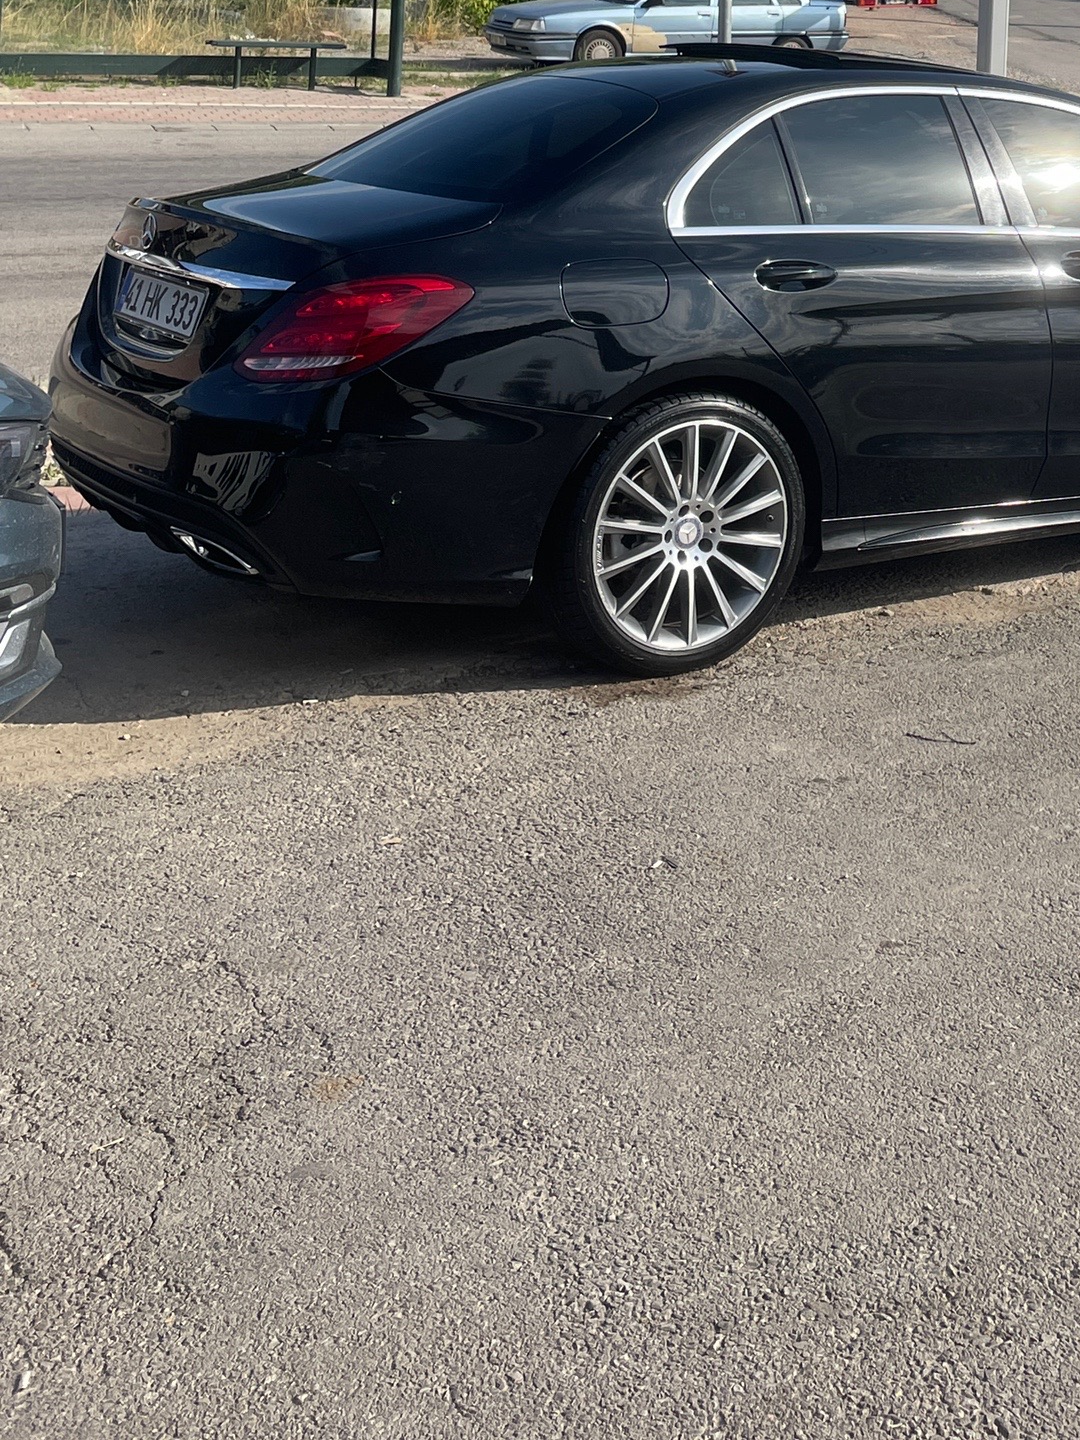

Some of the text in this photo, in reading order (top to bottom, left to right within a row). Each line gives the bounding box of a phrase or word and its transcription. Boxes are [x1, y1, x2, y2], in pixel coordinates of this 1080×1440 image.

[125, 278, 199, 330] 41 HK 333
